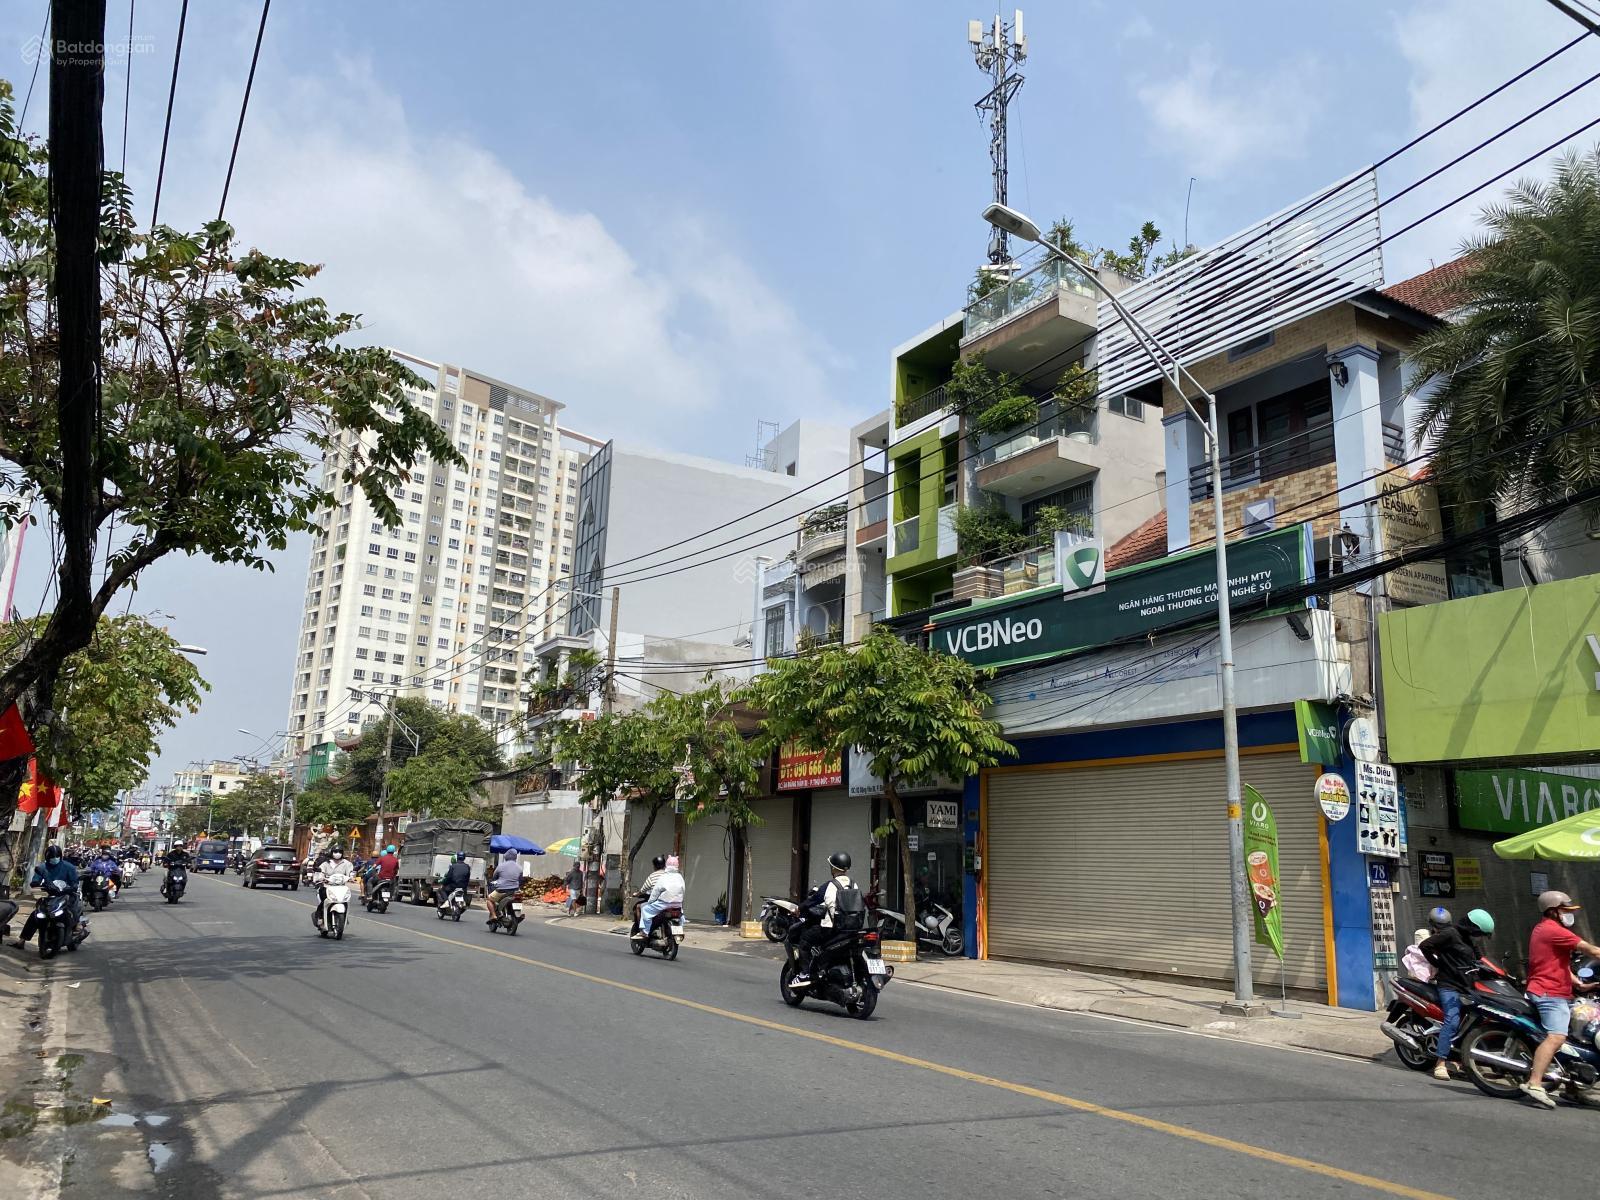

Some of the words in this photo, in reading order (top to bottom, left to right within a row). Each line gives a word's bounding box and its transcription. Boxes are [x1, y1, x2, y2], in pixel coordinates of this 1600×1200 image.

[1382, 496, 1419, 517] LEASING
[1118, 600, 1140, 611] NGÂN
[1142, 594, 1165, 605] HÀNG
[1166, 586, 1202, 600] THƯƠNG
[1250, 570, 1272, 582] MTV
[1167, 596, 1203, 611] THƯƠNG
[946, 617, 1042, 655] VCBNeo
[794, 762, 807, 778] 090
[808, 760, 822, 775] 666
[930, 804, 956, 815] YAMI
[1373, 864, 1386, 879] 78
